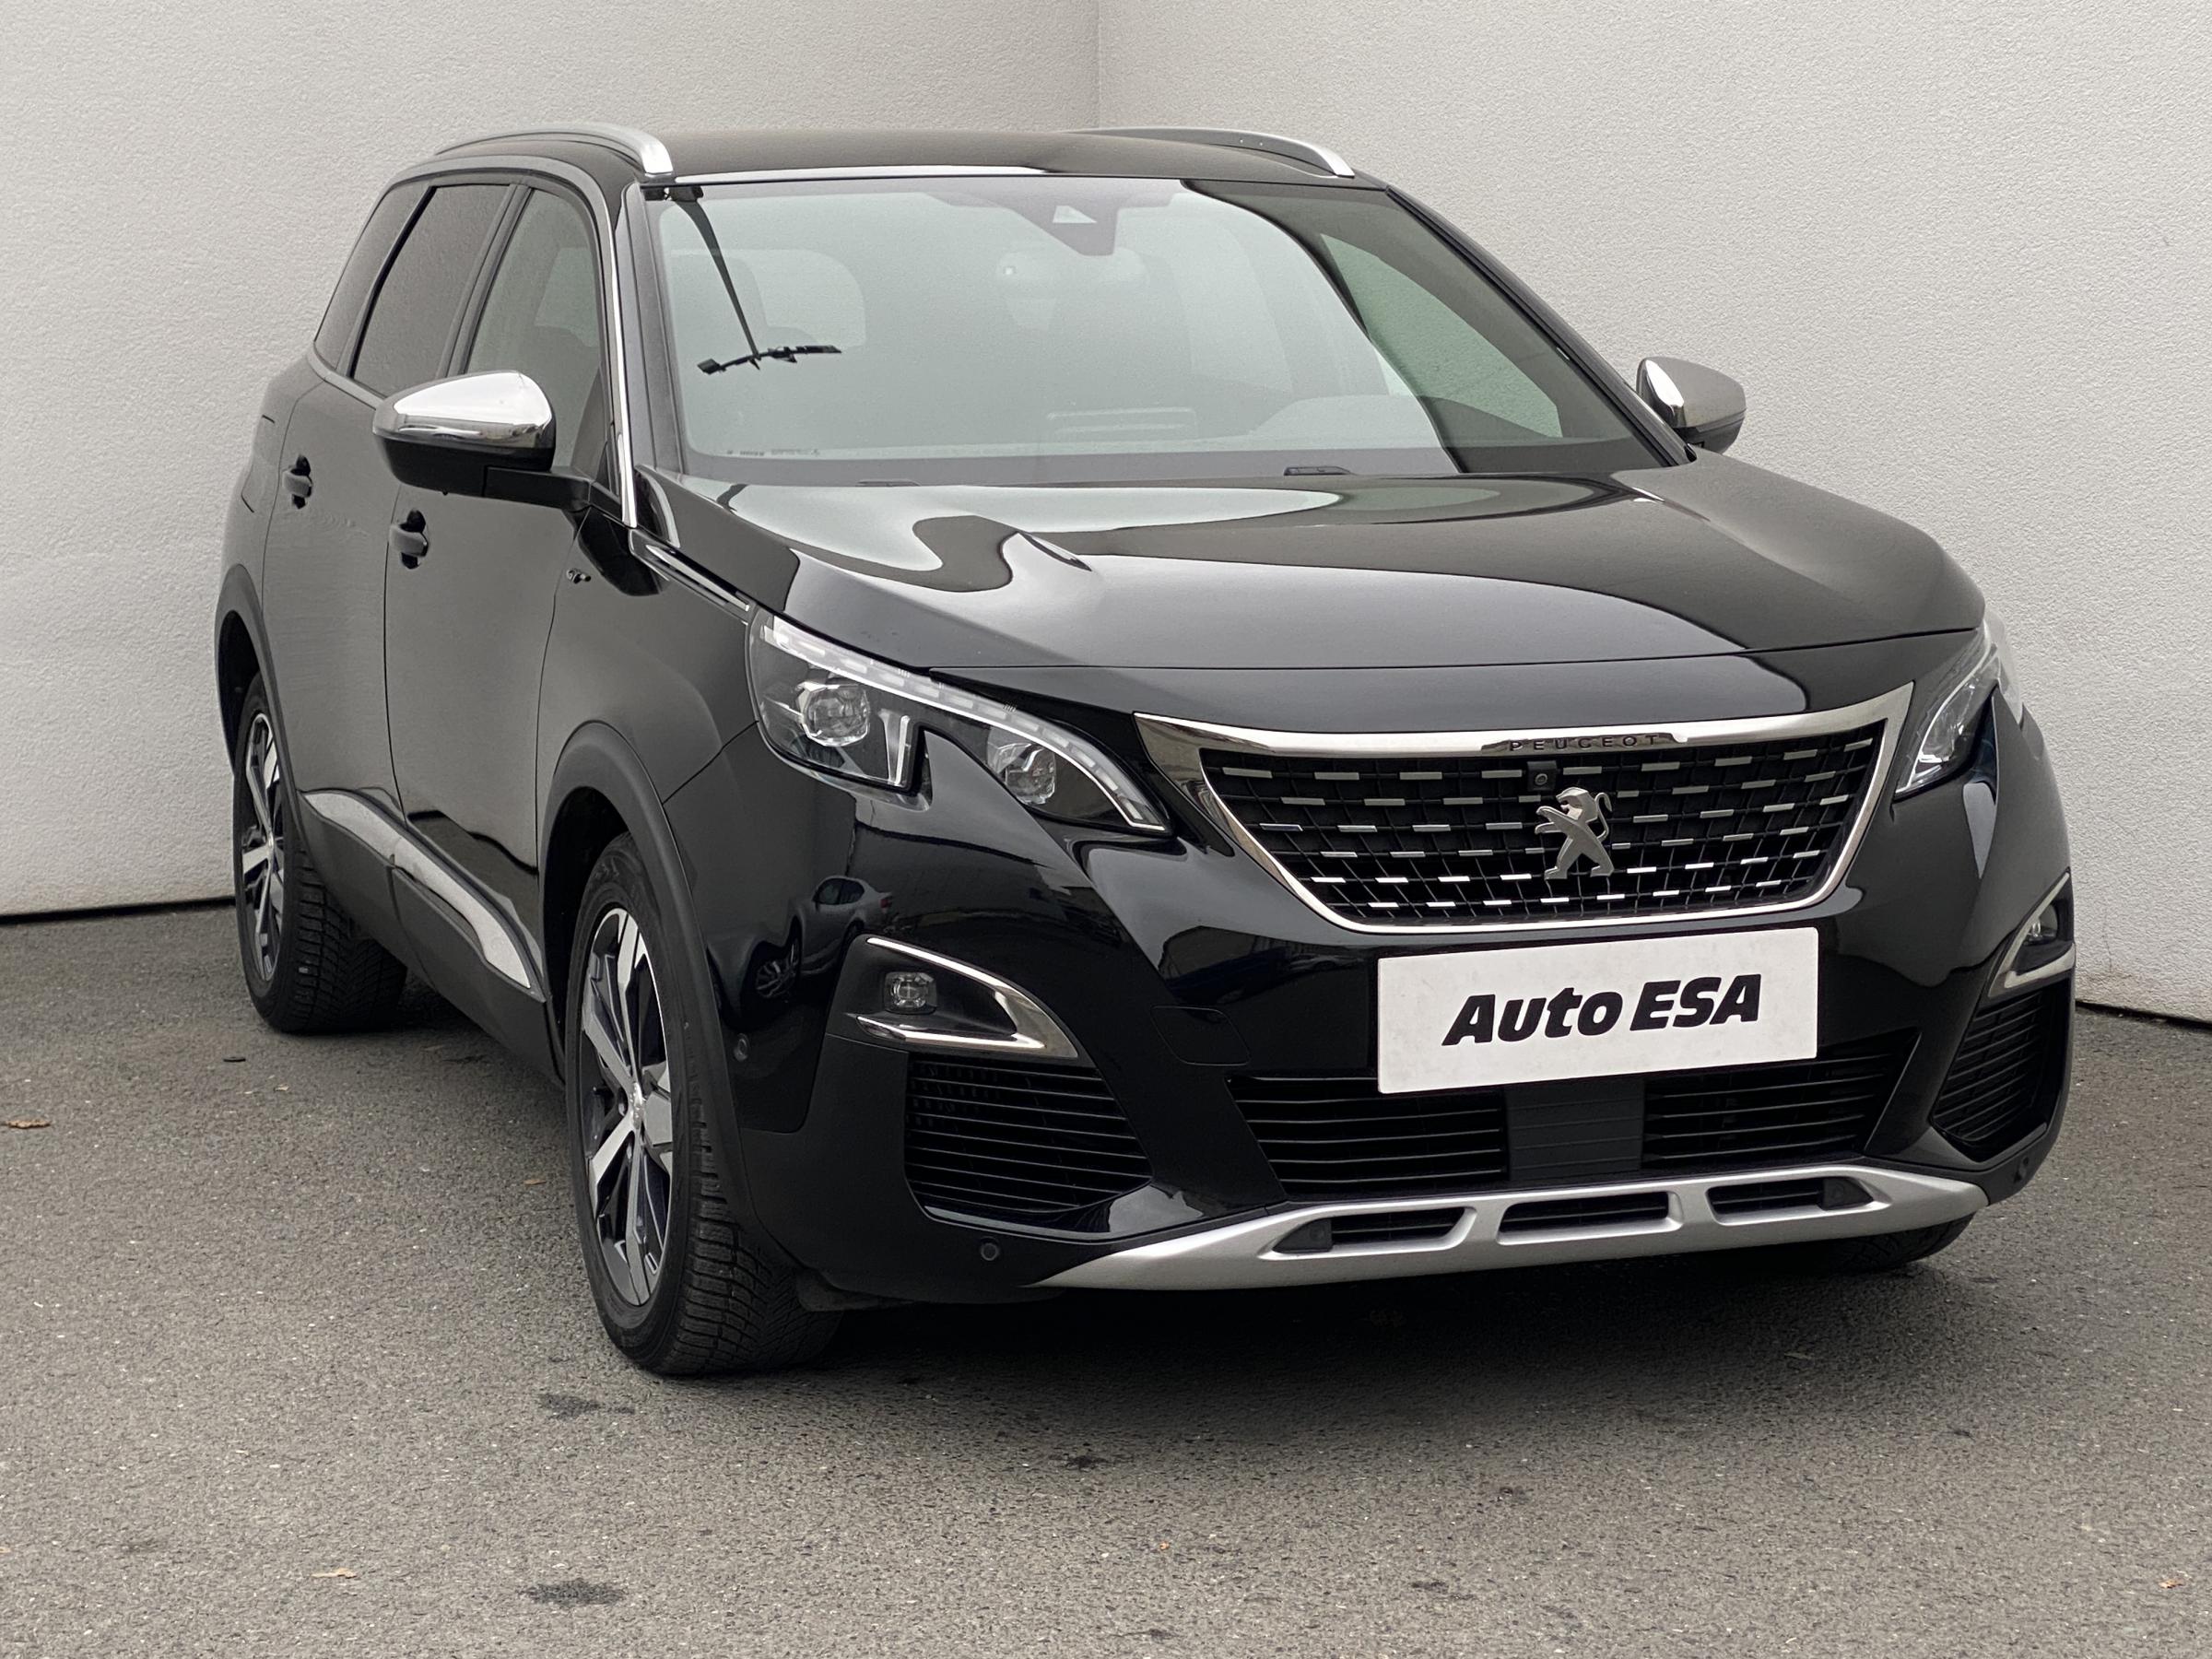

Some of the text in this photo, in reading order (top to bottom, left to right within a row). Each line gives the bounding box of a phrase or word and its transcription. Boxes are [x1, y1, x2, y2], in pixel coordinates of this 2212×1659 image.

[1508, 734, 1658, 752] PEUGEOT
[1441, 973, 1762, 1046] Auto ESA
